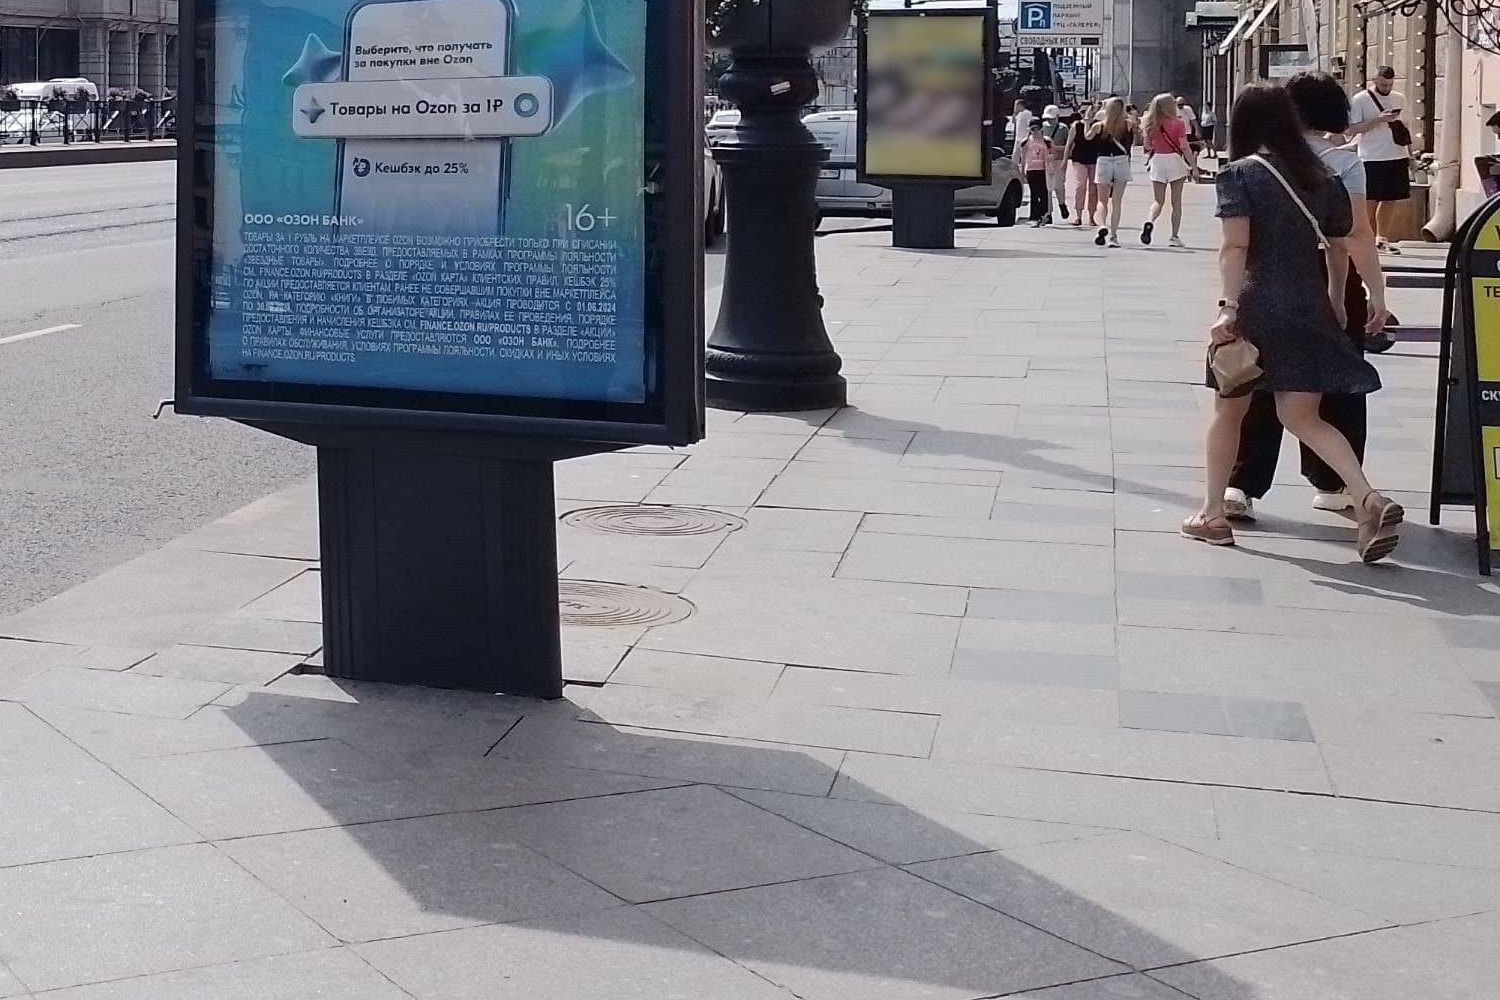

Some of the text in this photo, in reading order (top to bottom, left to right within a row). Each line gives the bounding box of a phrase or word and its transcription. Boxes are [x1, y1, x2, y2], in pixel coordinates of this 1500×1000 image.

[1019, 36, 1077, 46] СВОБОДНЫХ МЕСТ
[355, 42, 493, 56] Выберите, что получать
[354, 54, 473, 69] за покупки вне Ozon
[330, 102, 387, 119] Товары
[391, 104, 411, 115] на
[416, 99, 457, 114] Ozon
[462, 101, 481, 113] за
[375, 162, 469, 175] Кешбэк до 25%
[244, 214, 364, 226] ООО «ОЗОН БАНК»
[566, 203, 617, 231] 16+
[275, 232, 284, 242] ЗА
[462, 248, 467, 258] В
[365, 270, 371, 279] В
[374, 270, 408, 280] РАЗДЕЛЕ
[421, 284, 431, 293] НЕ
[243, 301, 253, 311] ПО
[503, 310, 514, 321] ЕЕ
[533, 324, 539, 334] В
[541, 324, 577, 335] РАЗДЕЛЕ
[473, 334, 491, 344] ООО
[1481, 390, 1500, 401] СК
